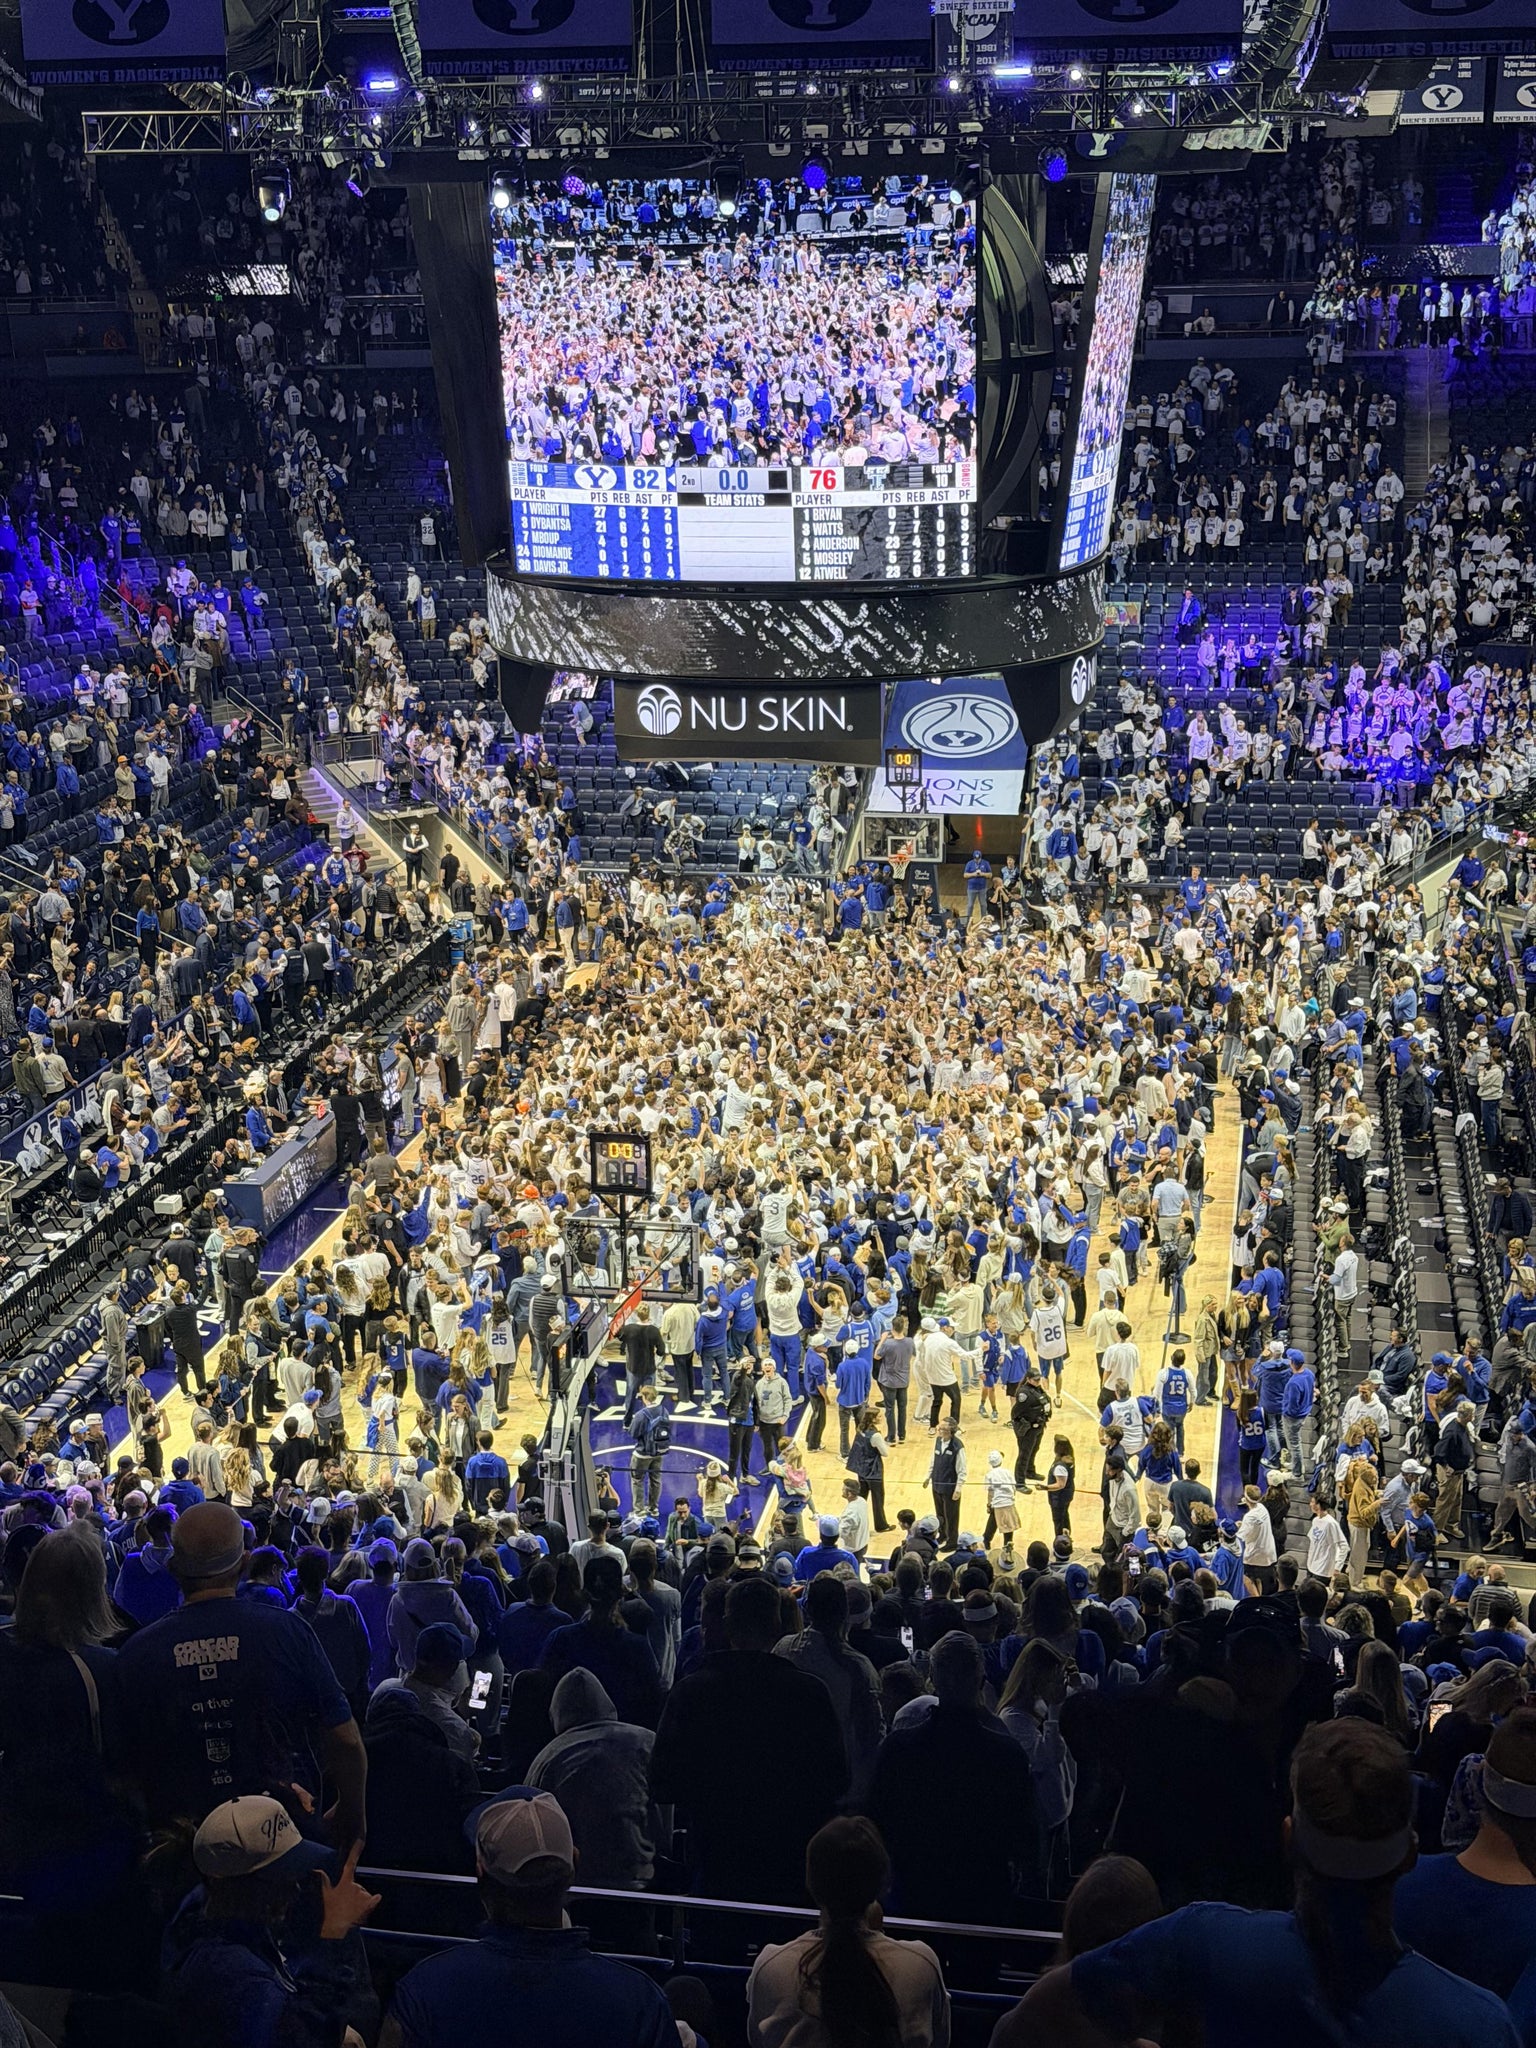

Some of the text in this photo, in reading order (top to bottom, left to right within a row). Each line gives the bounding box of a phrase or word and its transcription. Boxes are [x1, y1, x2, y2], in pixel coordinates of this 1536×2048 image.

[973, 1, 1008, 9] SIXTEEN
[1331, 43, 1427, 58] WOMEN'S
[425, 57, 629, 75] WOMEN'S BASKETBALL
[719, 55, 927, 71] WOMEN'S BASKETBALL
[976, 57, 997, 65] 2011
[31, 66, 223, 84] WOMEN'S BASKETBALL
[530, 464, 548, 473] FOULS
[932, 465, 952, 473] FOULS
[537, 474, 543, 486] 8
[633, 470, 660, 489] 82
[682, 475, 695, 485] 2ND
[719, 470, 748, 490] 0.0
[810, 470, 836, 489] 76
[936, 474, 948, 487] 10
[514, 488, 673, 504] PLAYER PTS REB AST PF
[704, 494, 765, 506] TEAM STATS
[796, 490, 970, 505] PLAYER PTS REB AST PF
[522, 503, 527, 513] 1
[529, 503, 560, 516] WRIGHT
[594, 506, 606, 518] 27
[641, 508, 649, 520] 2
[664, 508, 672, 520] 2
[803, 504, 969, 521] 1 BRYAN 0 1 1 0
[422, 526, 433, 534] 32
[521, 517, 528, 528] 3
[531, 517, 571, 531] DYBANTSA
[595, 521, 607, 533] 21
[641, 522, 650, 534] 4
[665, 523, 672, 535] 0
[802, 519, 969, 536] 3 WATTS 7 7 0 3
[522, 531, 529, 543] 7
[531, 531, 560, 545] MBOUP
[598, 536, 606, 548] 4
[643, 537, 650, 549] 0
[666, 538, 673, 550] 2
[801, 533, 969, 550] 4 ANDERSON 23 4 9 2
[517, 545, 673, 564] 24 DIOMANDE 0 1 0 1
[803, 548, 968, 565] 5 MOSELEY 5 2 0 1
[518, 559, 675, 579] 30 DAVIS JR. 16 2 2 4
[799, 563, 969, 580] 12 ATWELL 23 6 2 3
[691, 697, 747, 731] NU
[471, 1175, 485, 1184] 26
[769, 1202, 779, 1215] 3
[492, 1333, 507, 1345] 25
[1043, 1325, 1061, 1342] 26
[1169, 1381, 1185, 1395] 13
[1124, 1413, 1133, 1425] 3
[1245, 1421, 1263, 1437] 26
[173, 1636, 240, 1656] COUGAR
[175, 1647, 239, 1667] NATION
